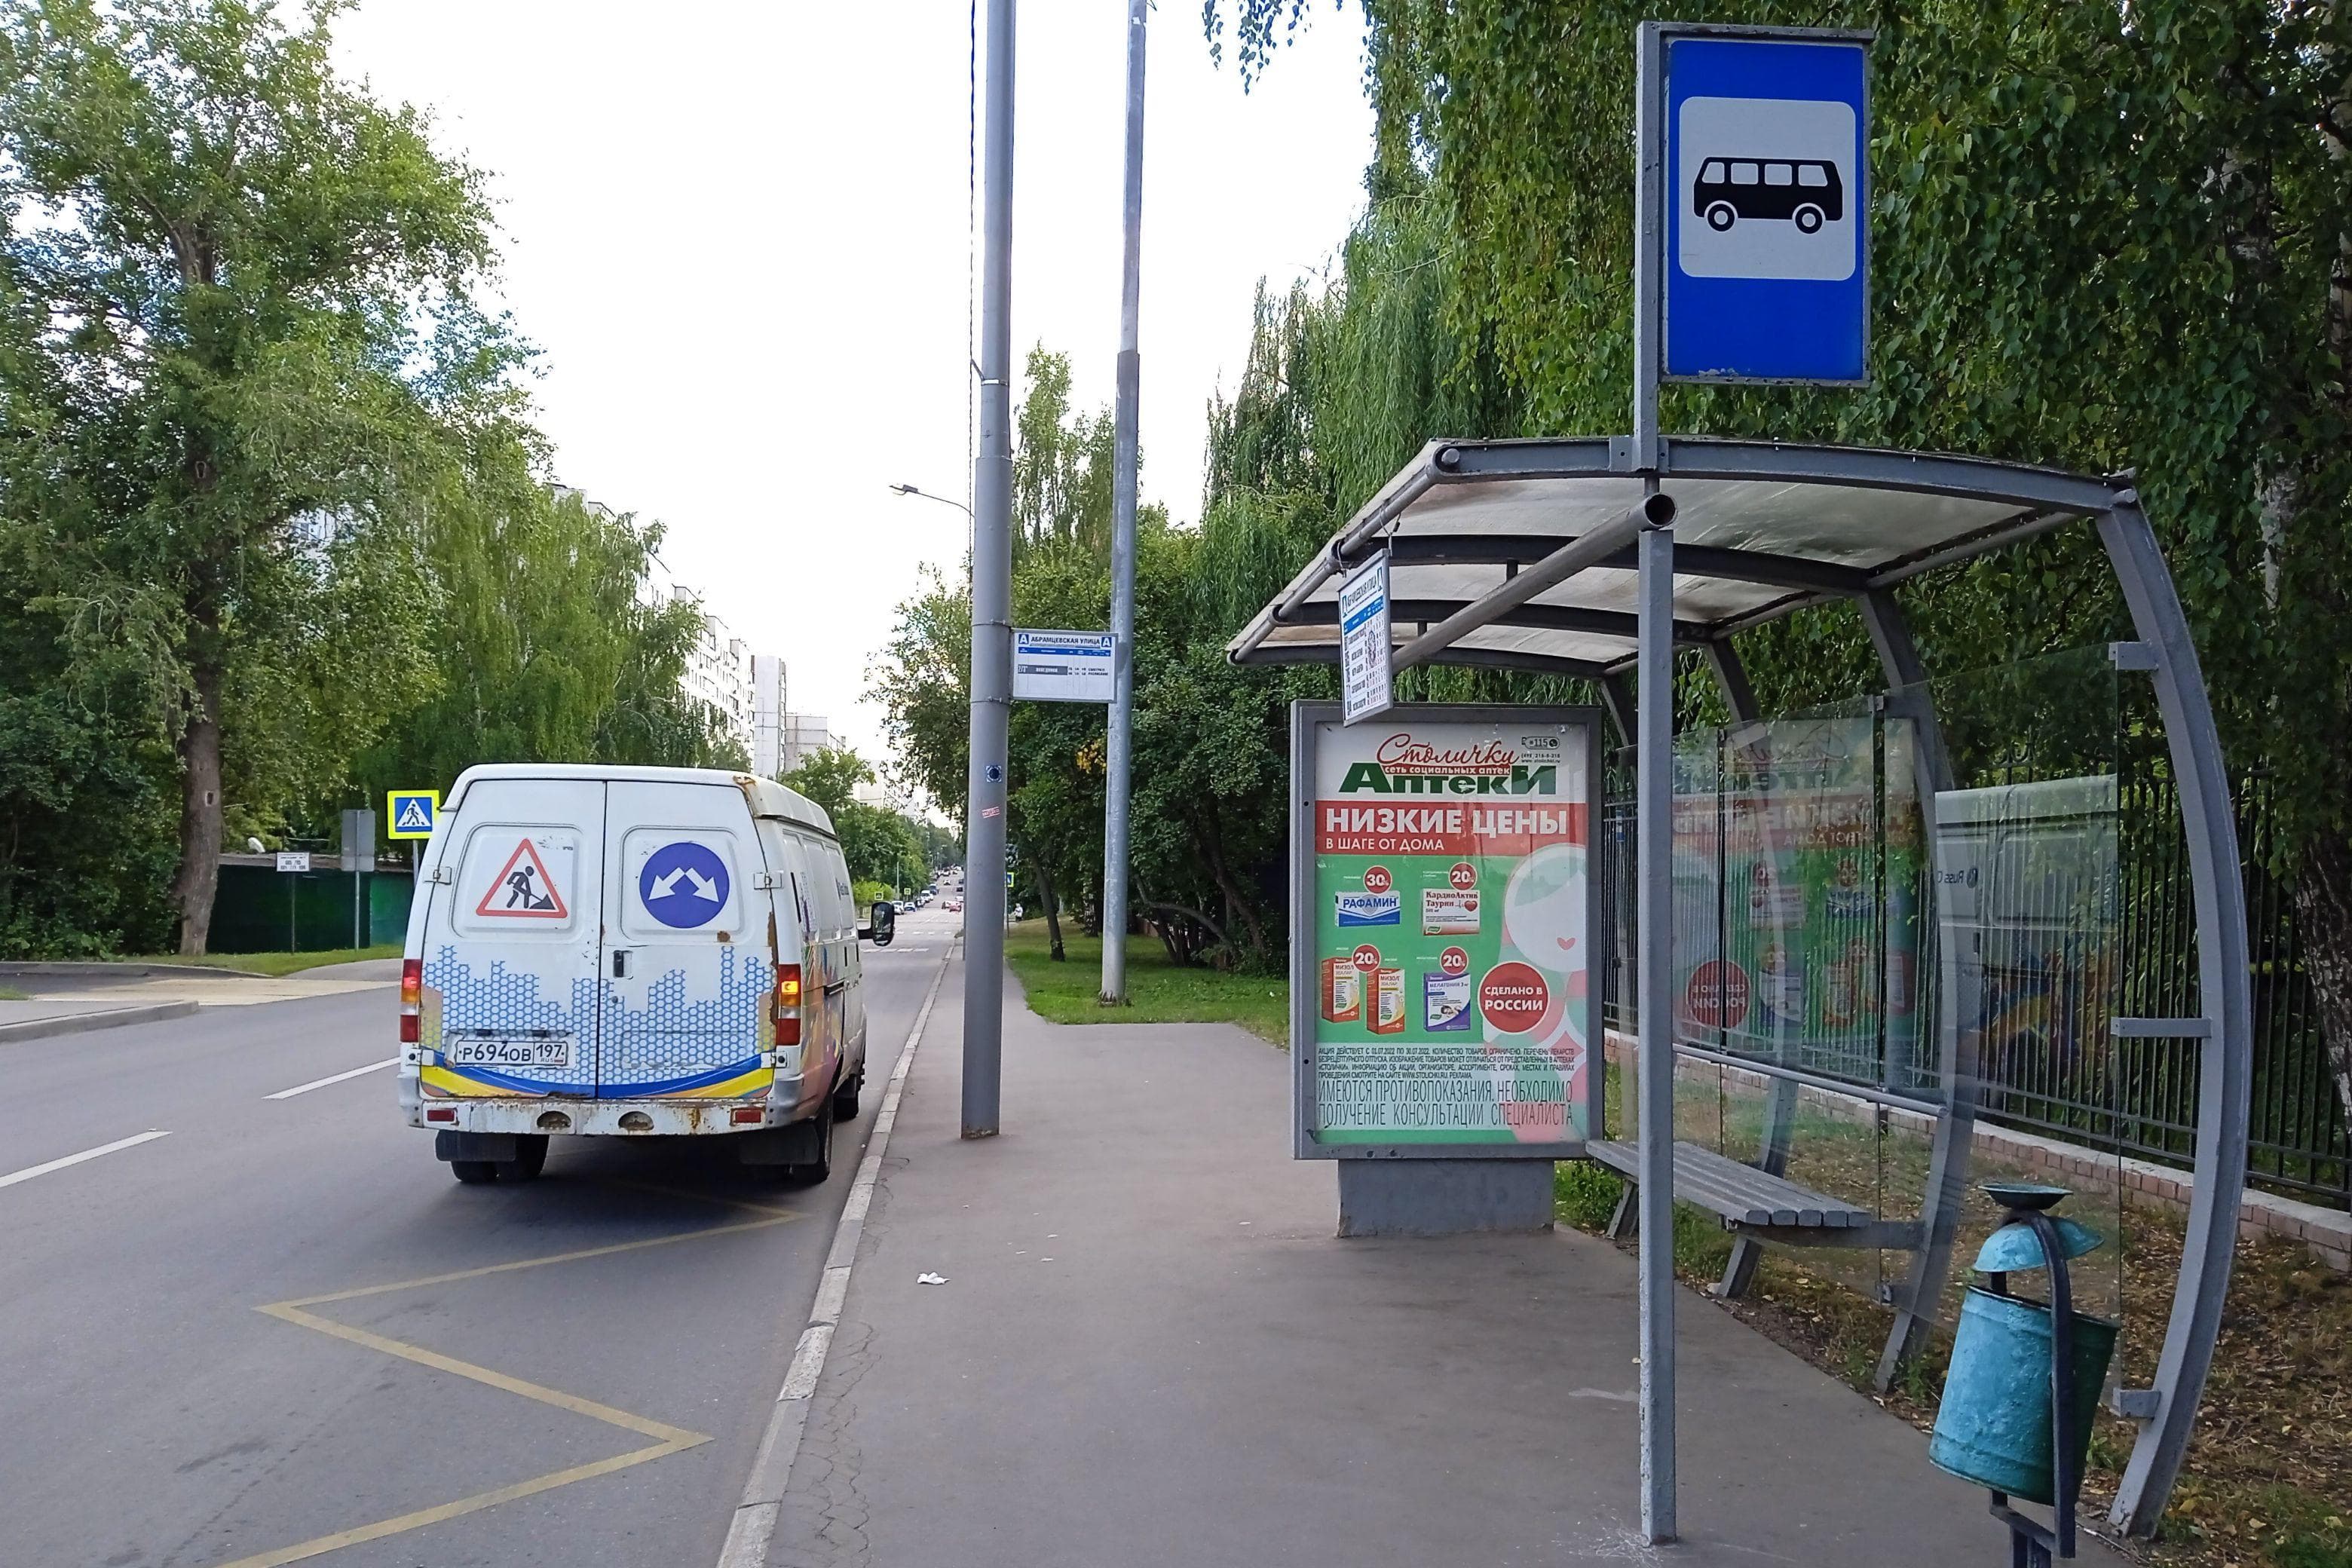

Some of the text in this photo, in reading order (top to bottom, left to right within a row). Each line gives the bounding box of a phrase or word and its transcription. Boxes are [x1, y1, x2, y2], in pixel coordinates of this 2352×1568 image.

[1031, 636, 1078, 645] АБРАМЦЕВСКАЯ
[1377, 733, 1520, 764] Столички
[1410, 767, 1476, 775] социальных
[1326, 808, 1566, 838] НИЗКИЕ ЦЕНЫ
[1326, 838, 1444, 851] В ШАГЕ ОТ ДОМА
[1343, 898, 1396, 908] РАФАМИН
[1484, 987, 1542, 996] СДЕЛАНО В
[1484, 1000, 1543, 1010] РОССИИ
[462, 1043, 562, 1061] Р694ОВ 197
[1318, 1080, 1573, 1103] ИМЕЮТСЯ ПРОТИВОПОКАЗАНИЯ. НЕОБХОДИМО
[1319, 1104, 1573, 1128] ПОЛУЧЕНИЕ КОНСУЛЬТАЦИИ СПЕЦИАЛИСТА
